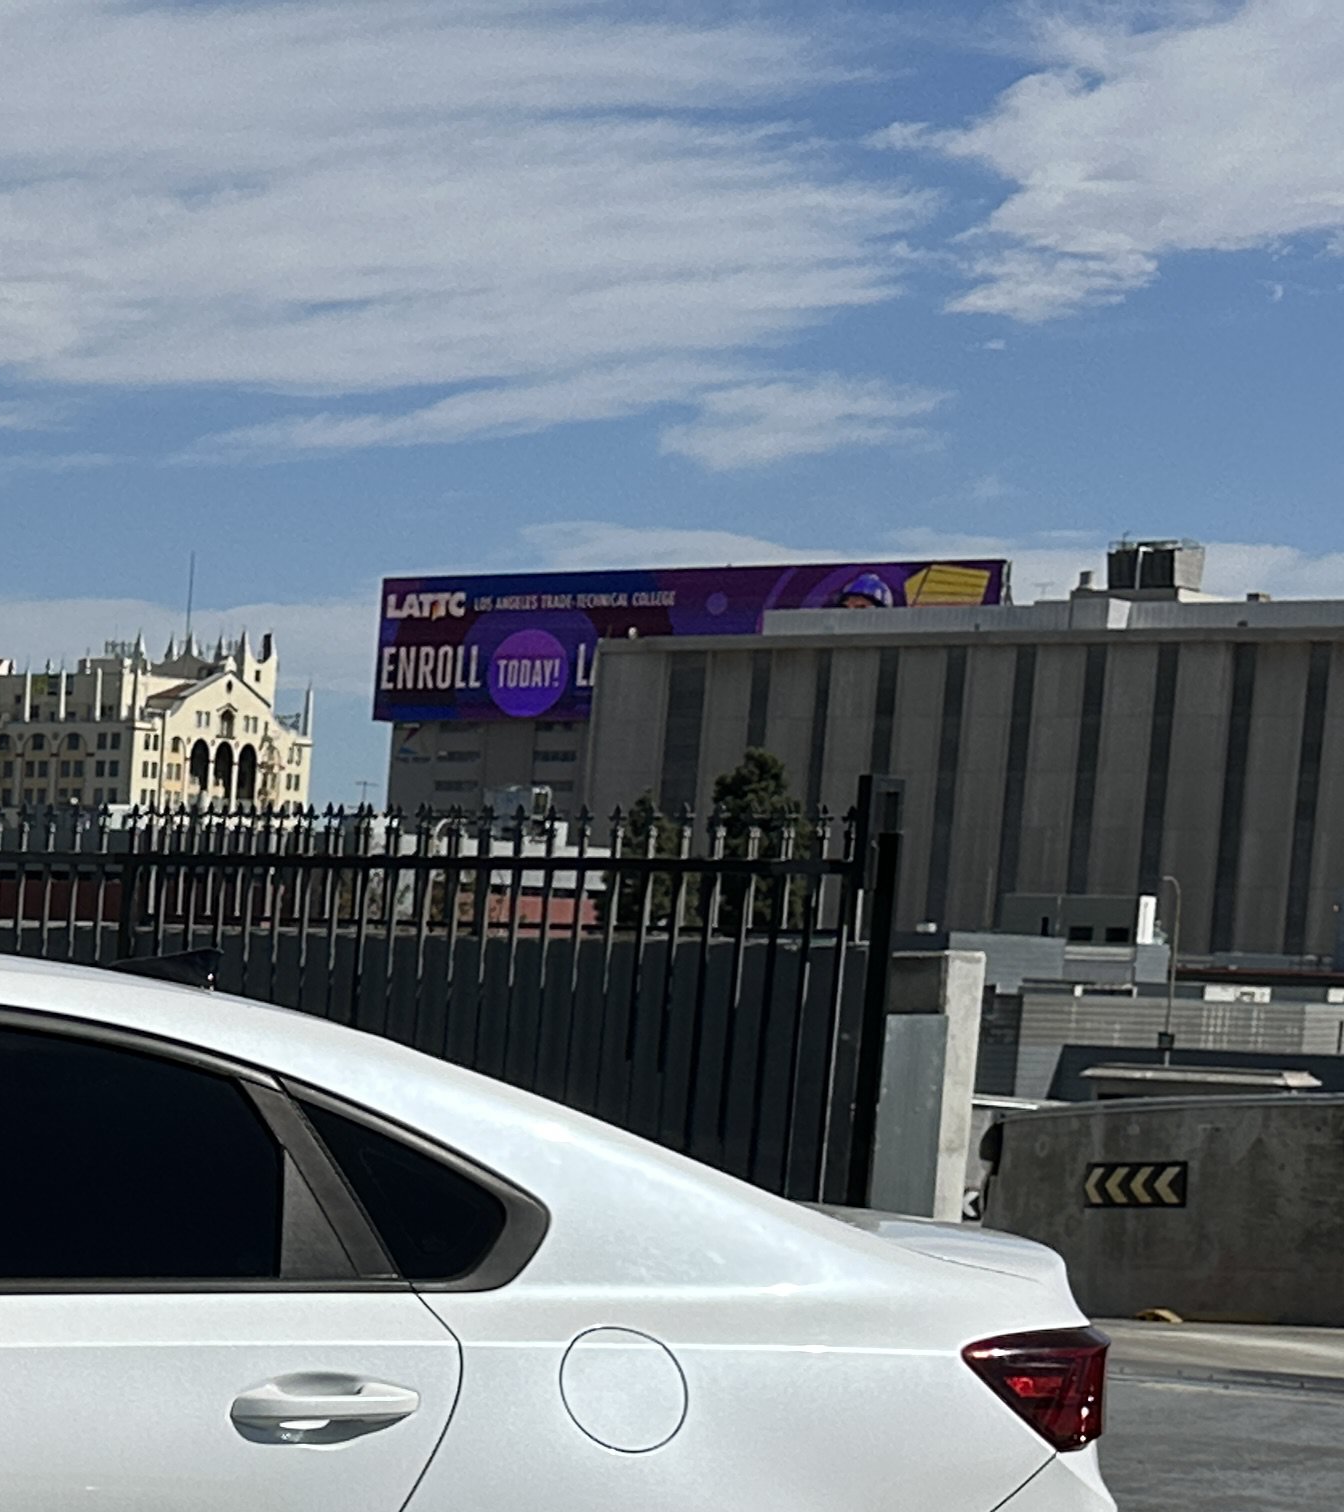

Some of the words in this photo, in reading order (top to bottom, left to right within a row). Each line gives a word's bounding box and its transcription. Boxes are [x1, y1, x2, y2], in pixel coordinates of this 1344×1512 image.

[386, 592, 466, 620] LATTC
[474, 596, 493, 611] LOS
[495, 594, 537, 611] ANGELES
[632, 591, 676, 607] COLLEGE
[380, 645, 481, 690] ENROLL
[497, 658, 561, 688] TODAY!
